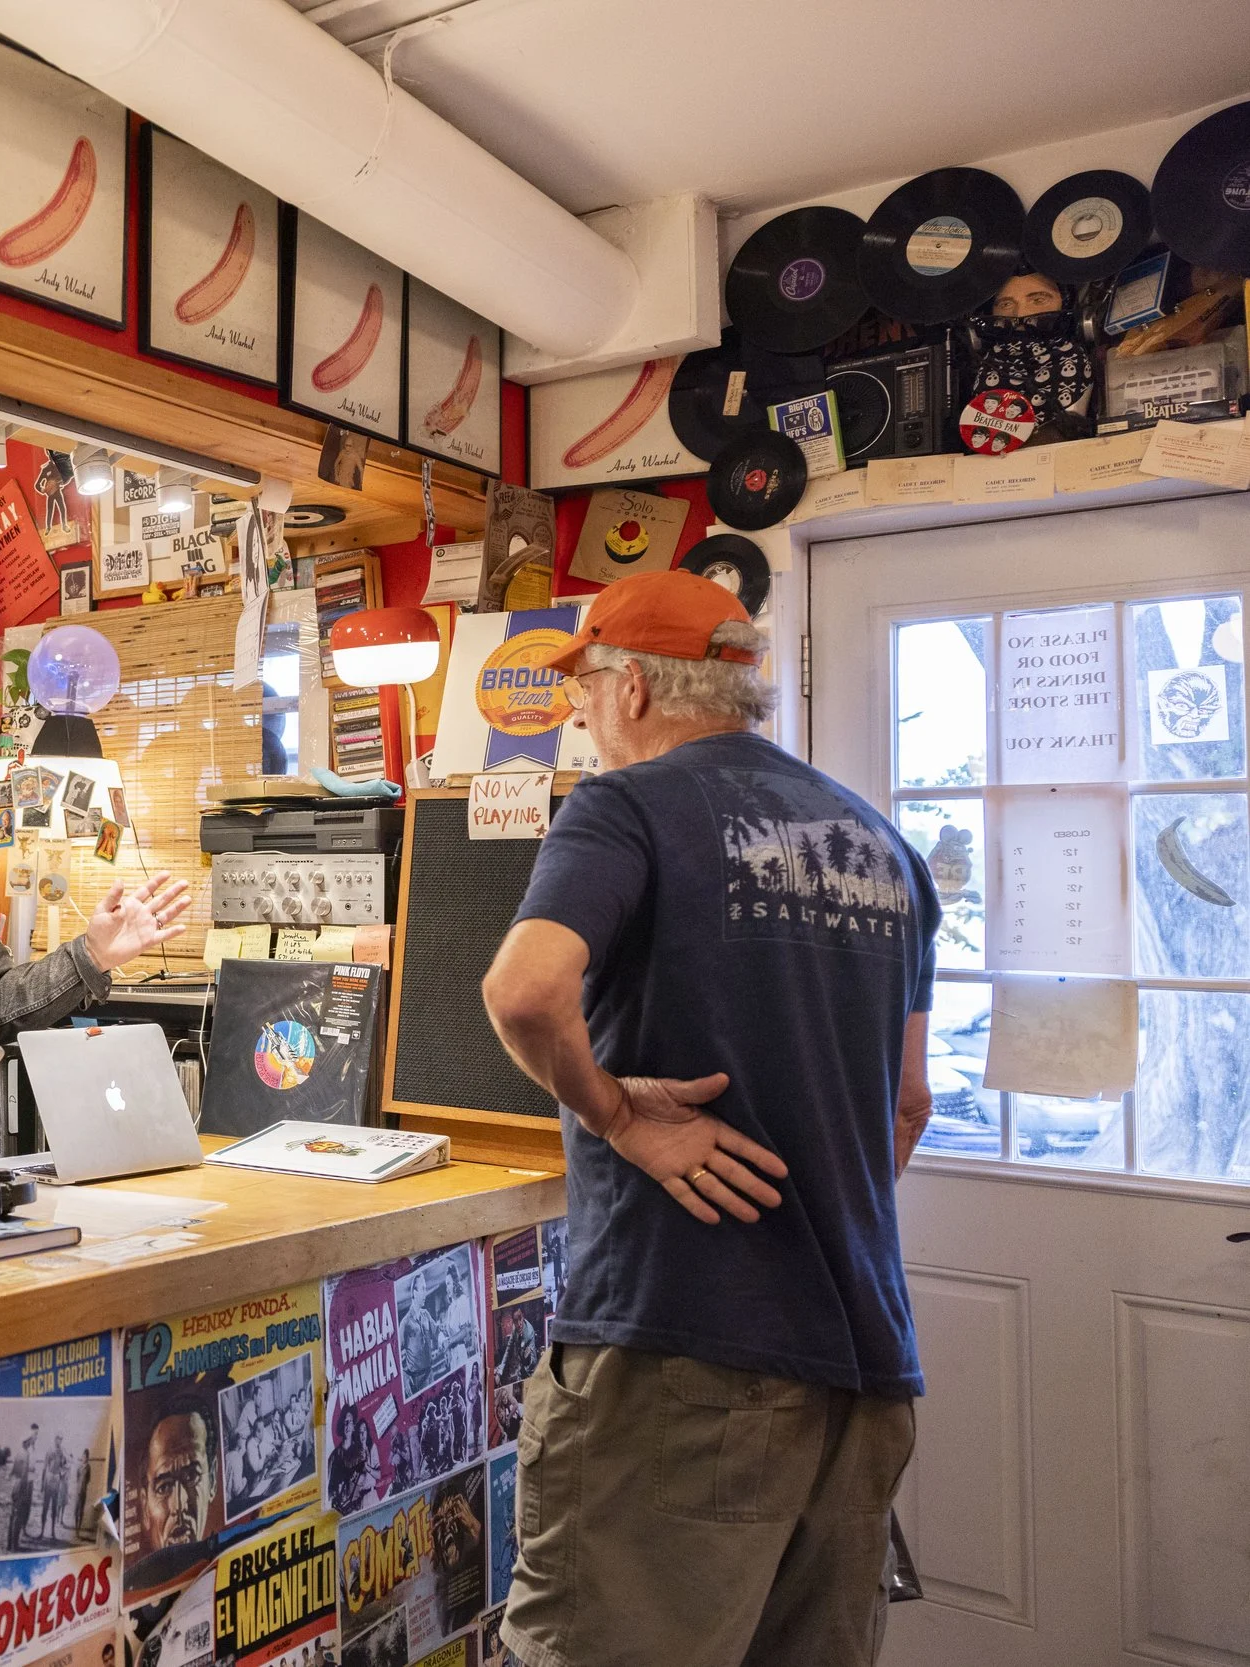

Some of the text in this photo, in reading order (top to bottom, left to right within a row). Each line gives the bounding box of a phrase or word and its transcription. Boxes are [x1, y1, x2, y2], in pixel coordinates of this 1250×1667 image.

[34, 268, 96, 302] Andy Warhol
[784, 266, 799, 297] Capitol
[205, 324, 256, 352] Andy Warhol
[1003, 391, 1018, 401] I'm
[337, 397, 381, 425] Andy Warhol
[973, 411, 1020, 434] BEATLES FAN
[1143, 401, 1189, 419] BEATLES
[448, 438, 485, 461] Andy Warhol
[607, 452, 681, 475] Andy Warhol
[1089, 464, 1107, 473] CADET
[620, 490, 654, 514] Solo
[814, 495, 832, 505] CADET
[172, 531, 216, 552] BLACK
[511, 714, 544, 722] QUALITY
[473, 778, 530, 802] NOW
[473, 805, 542, 832] PLAYING
[333, 964, 371, 978] PINK FLOYD
[182, 1293, 291, 1338] HENRY FONDA
[173, 1313, 322, 1379] HOMBRES PUGNA
[339, 1302, 395, 1364] HABLA
[21, 1335, 99, 1376] JULIO ALDAMA
[125, 1322, 173, 1393] 12
[21, 1356, 106, 1398] DACIA GONZALEZ
[338, 1342, 398, 1406] MANILA
[229, 1525, 315, 1583] BRUCE LEI
[216, 1596, 235, 1640] EL
[236, 1549, 336, 1651] MAGNIFICO
[423, 1641, 463, 1667] DRAGON LEE
